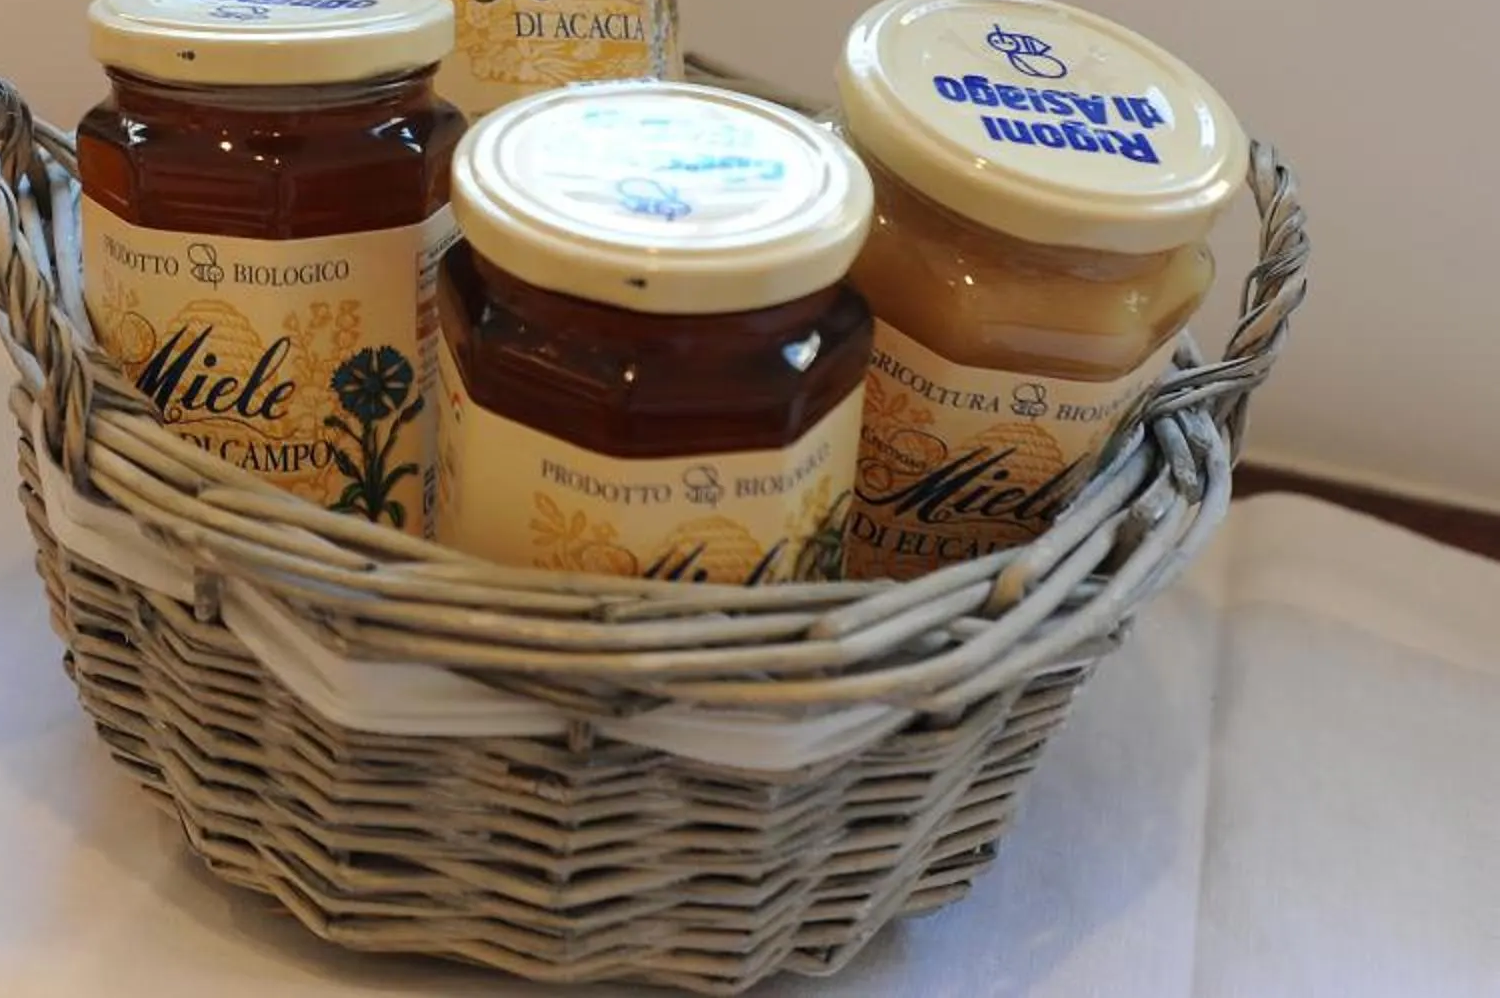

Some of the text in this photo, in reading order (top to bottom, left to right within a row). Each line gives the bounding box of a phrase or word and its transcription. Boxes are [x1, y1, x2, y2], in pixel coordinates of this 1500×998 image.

[515, 11, 645, 42] DI ACACIA
[933, 75, 1165, 129] di Asiago
[981, 115, 1160, 164] Rigoni
[233, 259, 350, 286] BIOLOGICO
[132, 324, 297, 426] Miele
[870, 350, 1000, 414] GRICOLTURA
[220, 439, 332, 473] CAMPO
[540, 458, 671, 506] PRODOTTO
[851, 512, 885, 549] DI
